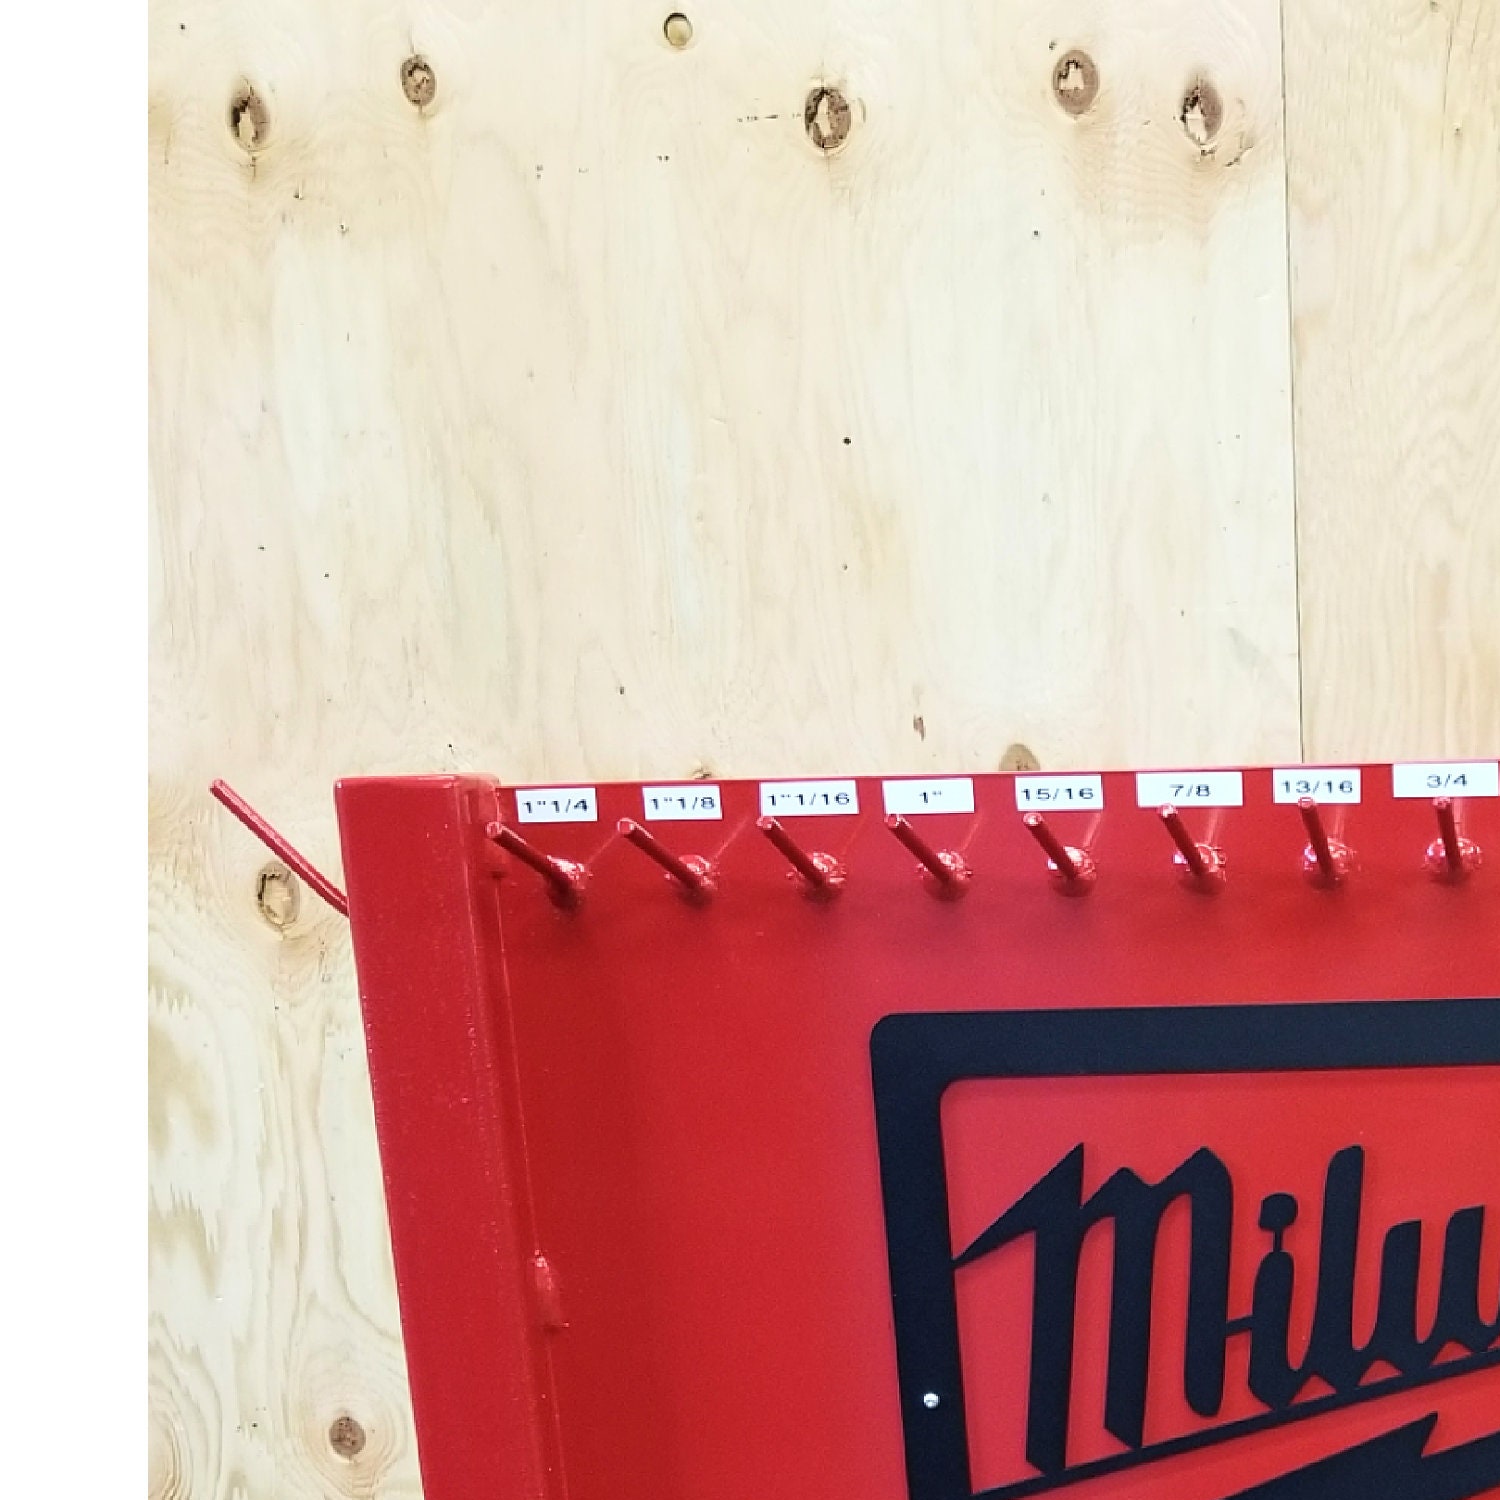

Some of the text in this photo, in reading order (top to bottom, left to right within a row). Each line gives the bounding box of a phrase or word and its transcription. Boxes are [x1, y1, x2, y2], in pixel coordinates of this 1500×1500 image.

[1280, 779, 1354, 794] 13/16
[1426, 772, 1469, 788] 3/4
[1020, 787, 1095, 802] 15/16
[1168, 783, 1212, 798] 7/8
